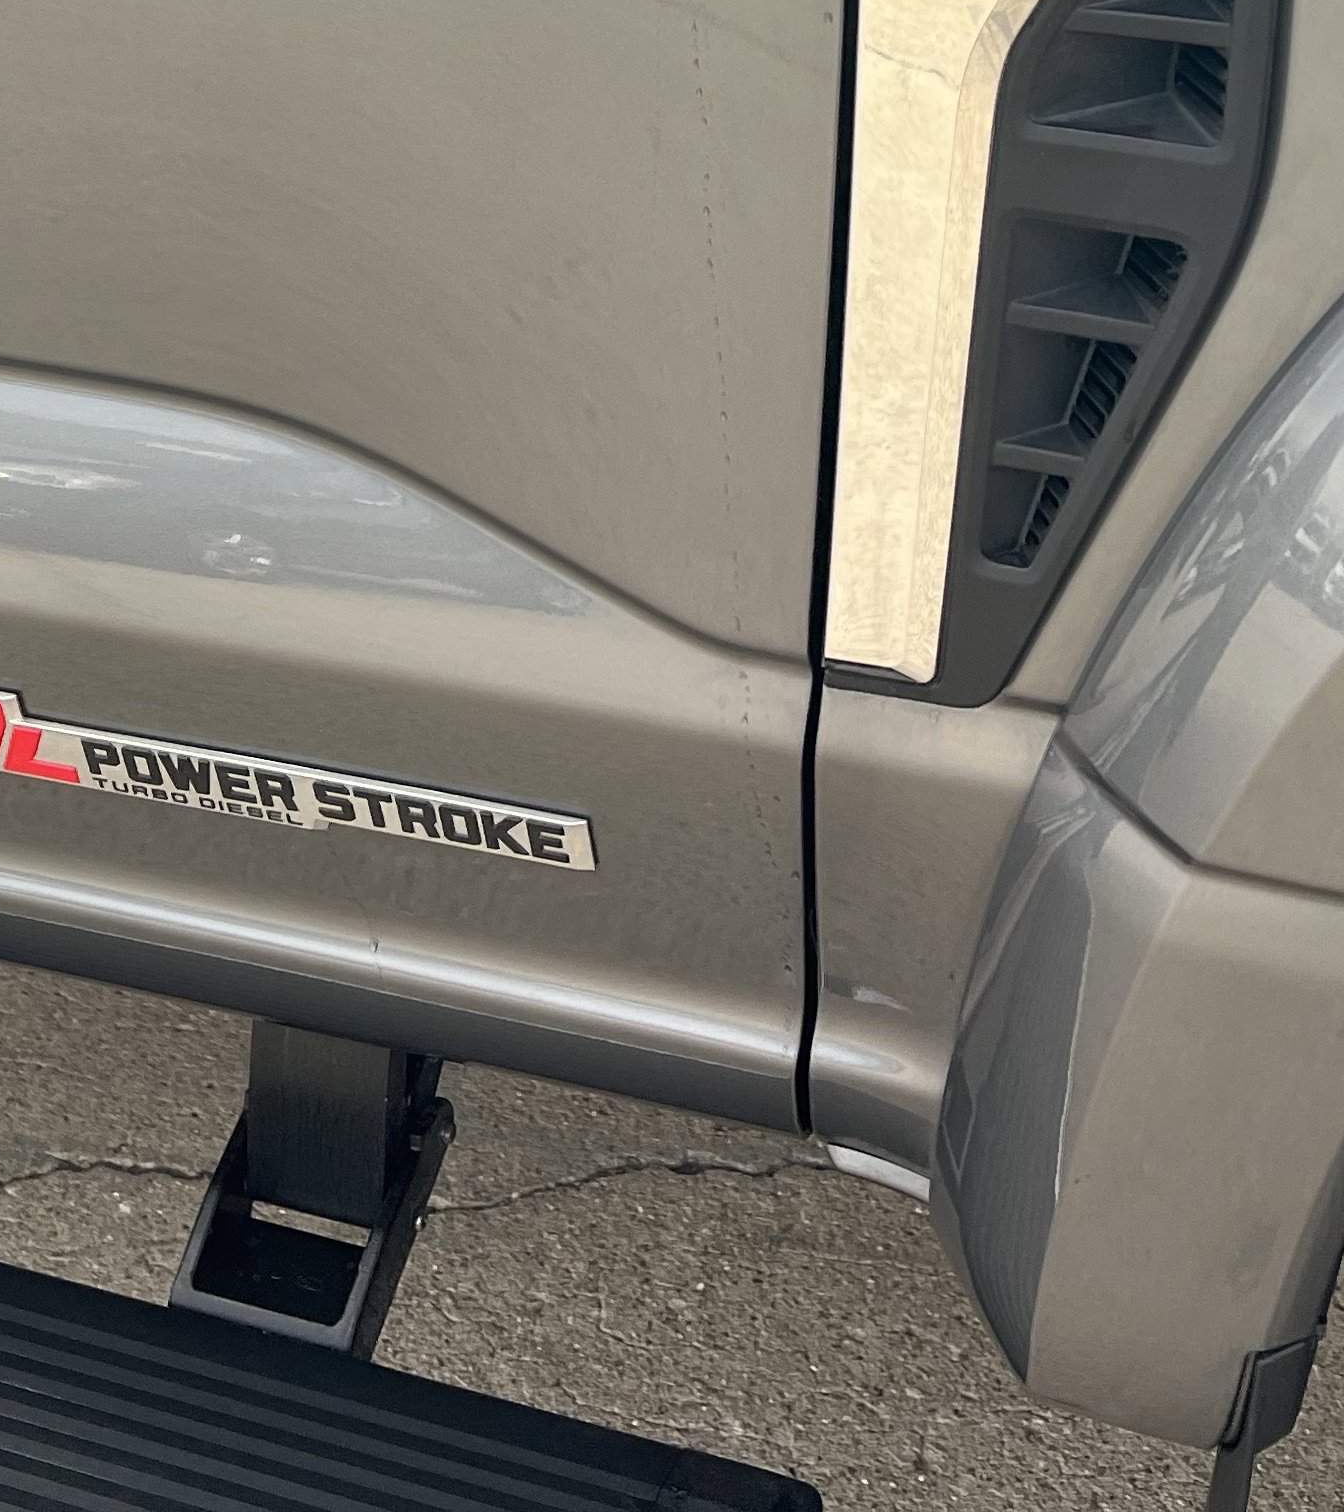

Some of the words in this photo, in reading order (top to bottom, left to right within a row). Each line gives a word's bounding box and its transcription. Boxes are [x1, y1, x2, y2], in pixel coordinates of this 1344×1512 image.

[81, 737, 299, 812] POWER
[311, 779, 571, 864] STROKE
[91, 776, 189, 805] TURBO
[198, 796, 304, 826] DIESEL
